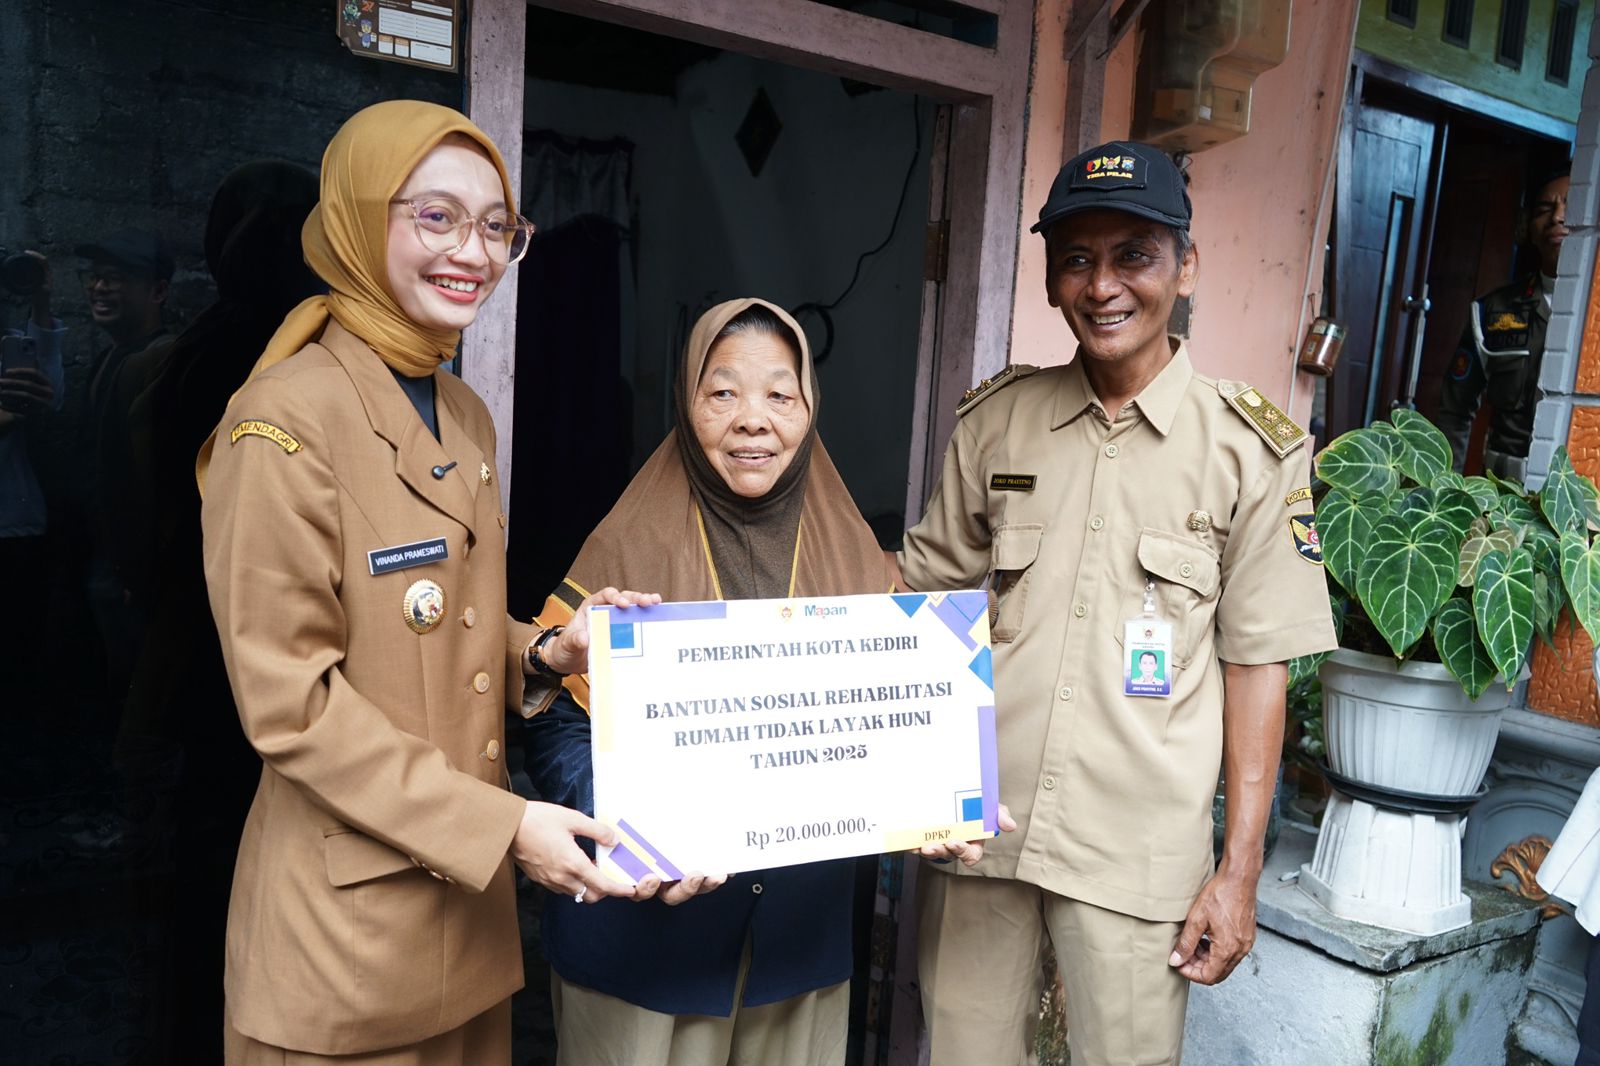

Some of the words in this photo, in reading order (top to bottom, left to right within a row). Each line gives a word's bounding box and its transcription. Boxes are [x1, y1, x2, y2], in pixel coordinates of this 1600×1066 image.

[1106, 171, 1132, 179] PILAR
[1289, 490, 1307, 502] KOTA
[374, 553, 404, 566] VINANDA
[404, 544, 444, 560] PRAMESWATI
[804, 604, 847, 619] Mapan
[678, 642, 801, 663] PEMERINTAH
[806, 639, 856, 656] KOTA
[860, 636, 919, 653] KEDIRI
[646, 697, 746, 719] BANTUAN
[751, 691, 821, 711] SOSIAL
[825, 681, 952, 706] REHABILITASI
[674, 726, 750, 747] RUMAH
[754, 720, 815, 740] TIDAK
[819, 714, 885, 735] LAYAK
[888, 710, 932, 729] HUNI
[750, 748, 819, 769] TAHUN
[822, 744, 868, 763] 2025
[745, 830, 770, 850] Rp
[775, 816, 877, 843] 20.000.000,-
[924, 829, 951, 842] DPKP
